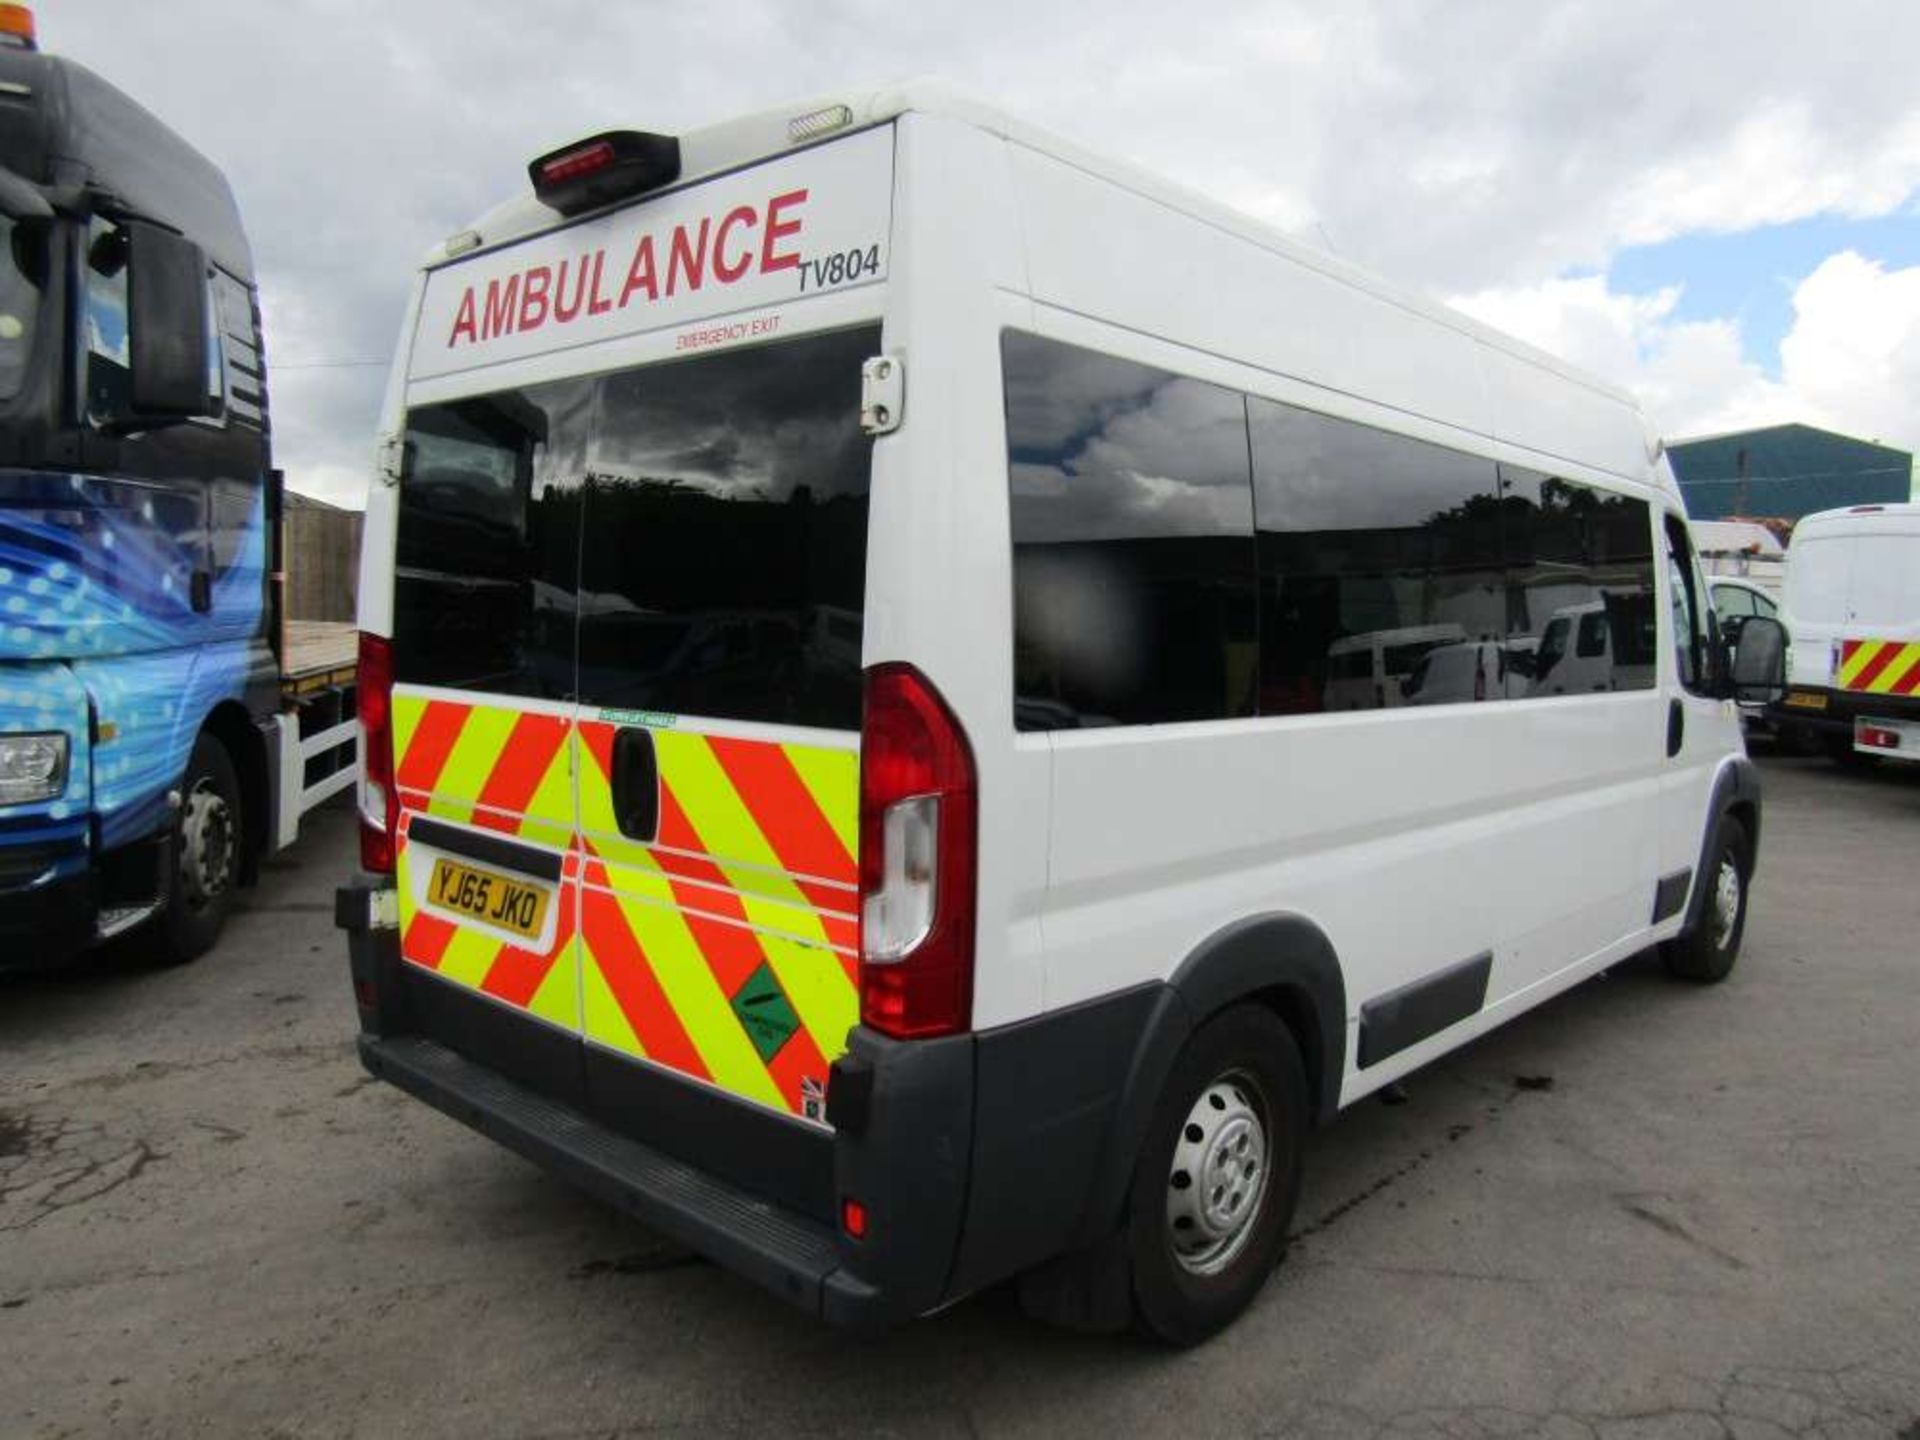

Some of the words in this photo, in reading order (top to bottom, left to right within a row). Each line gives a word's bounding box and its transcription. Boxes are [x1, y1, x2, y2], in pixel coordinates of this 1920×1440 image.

[448, 188, 808, 349] AMBULANCE
[797, 244, 880, 292] TV804
[751, 315, 780, 335] EXIT
[439, 865, 492, 914] YJ65
[491, 883, 537, 929] JKO
